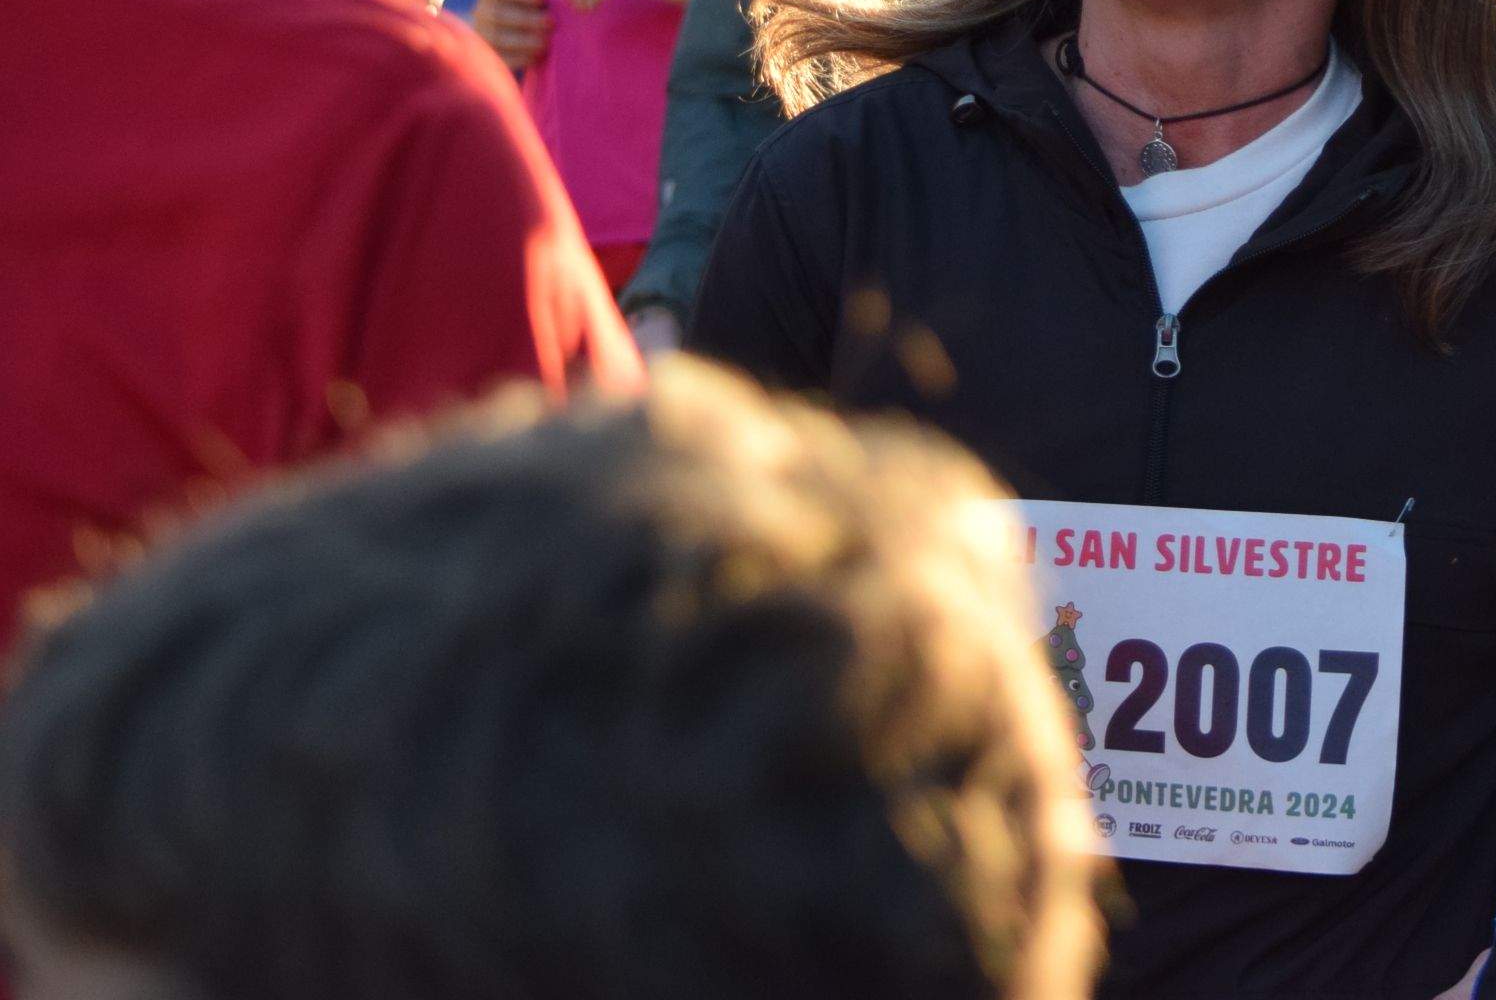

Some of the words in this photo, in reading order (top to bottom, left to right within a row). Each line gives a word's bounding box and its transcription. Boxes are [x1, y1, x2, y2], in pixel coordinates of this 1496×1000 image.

[1054, 528, 1138, 570] SAN
[1155, 534, 1367, 583] SILVESTRE
[1104, 638, 1380, 766] 2007
[1100, 779, 1275, 816] PONTEVEDRA
[1285, 791, 1357, 820] 2024
[1128, 821, 1163, 835] FROIZ
